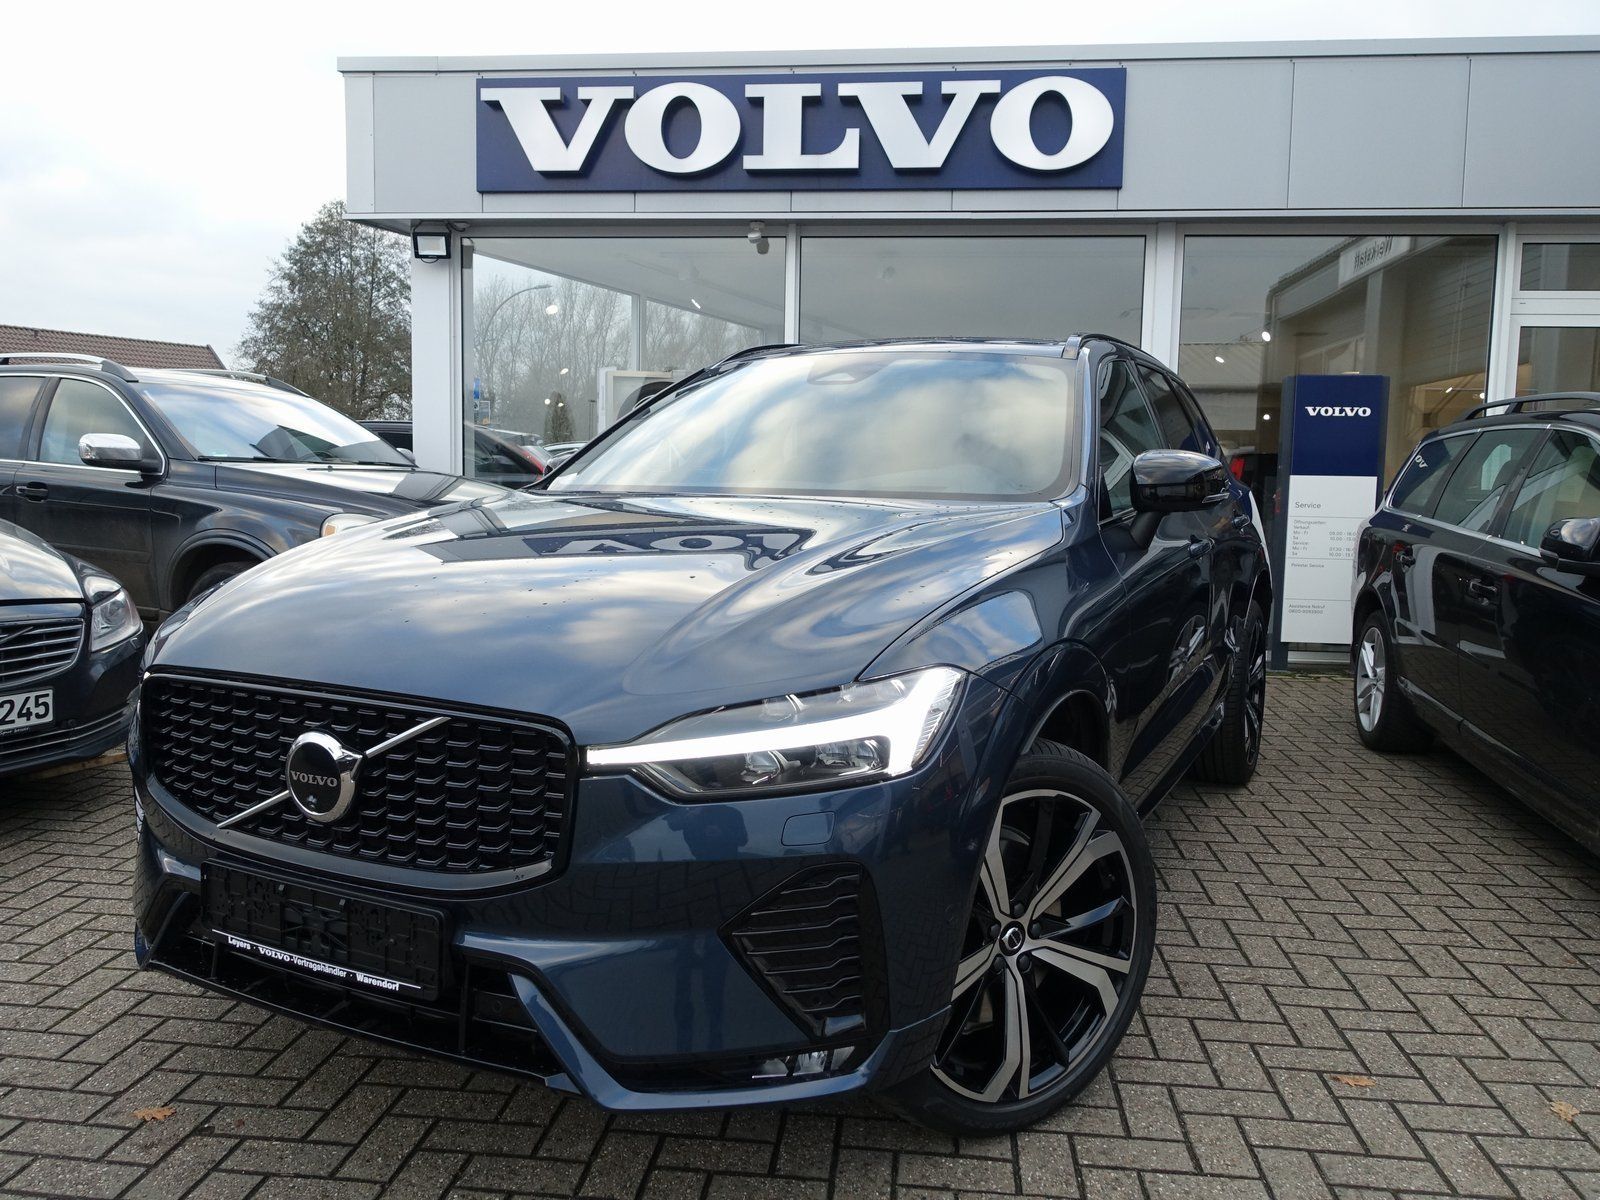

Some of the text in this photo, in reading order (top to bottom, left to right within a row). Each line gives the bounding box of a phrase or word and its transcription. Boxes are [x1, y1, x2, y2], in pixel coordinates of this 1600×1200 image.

[480, 75, 1114, 174] VOLVO
[1305, 406, 1371, 417] VOLVO
[1295, 501, 1321, 509] Service
[0, 693, 50, 725] 245
[290, 770, 338, 787] VOLVO
[228, 936, 251, 950] Leyers
[356, 973, 400, 991] Warendorf
